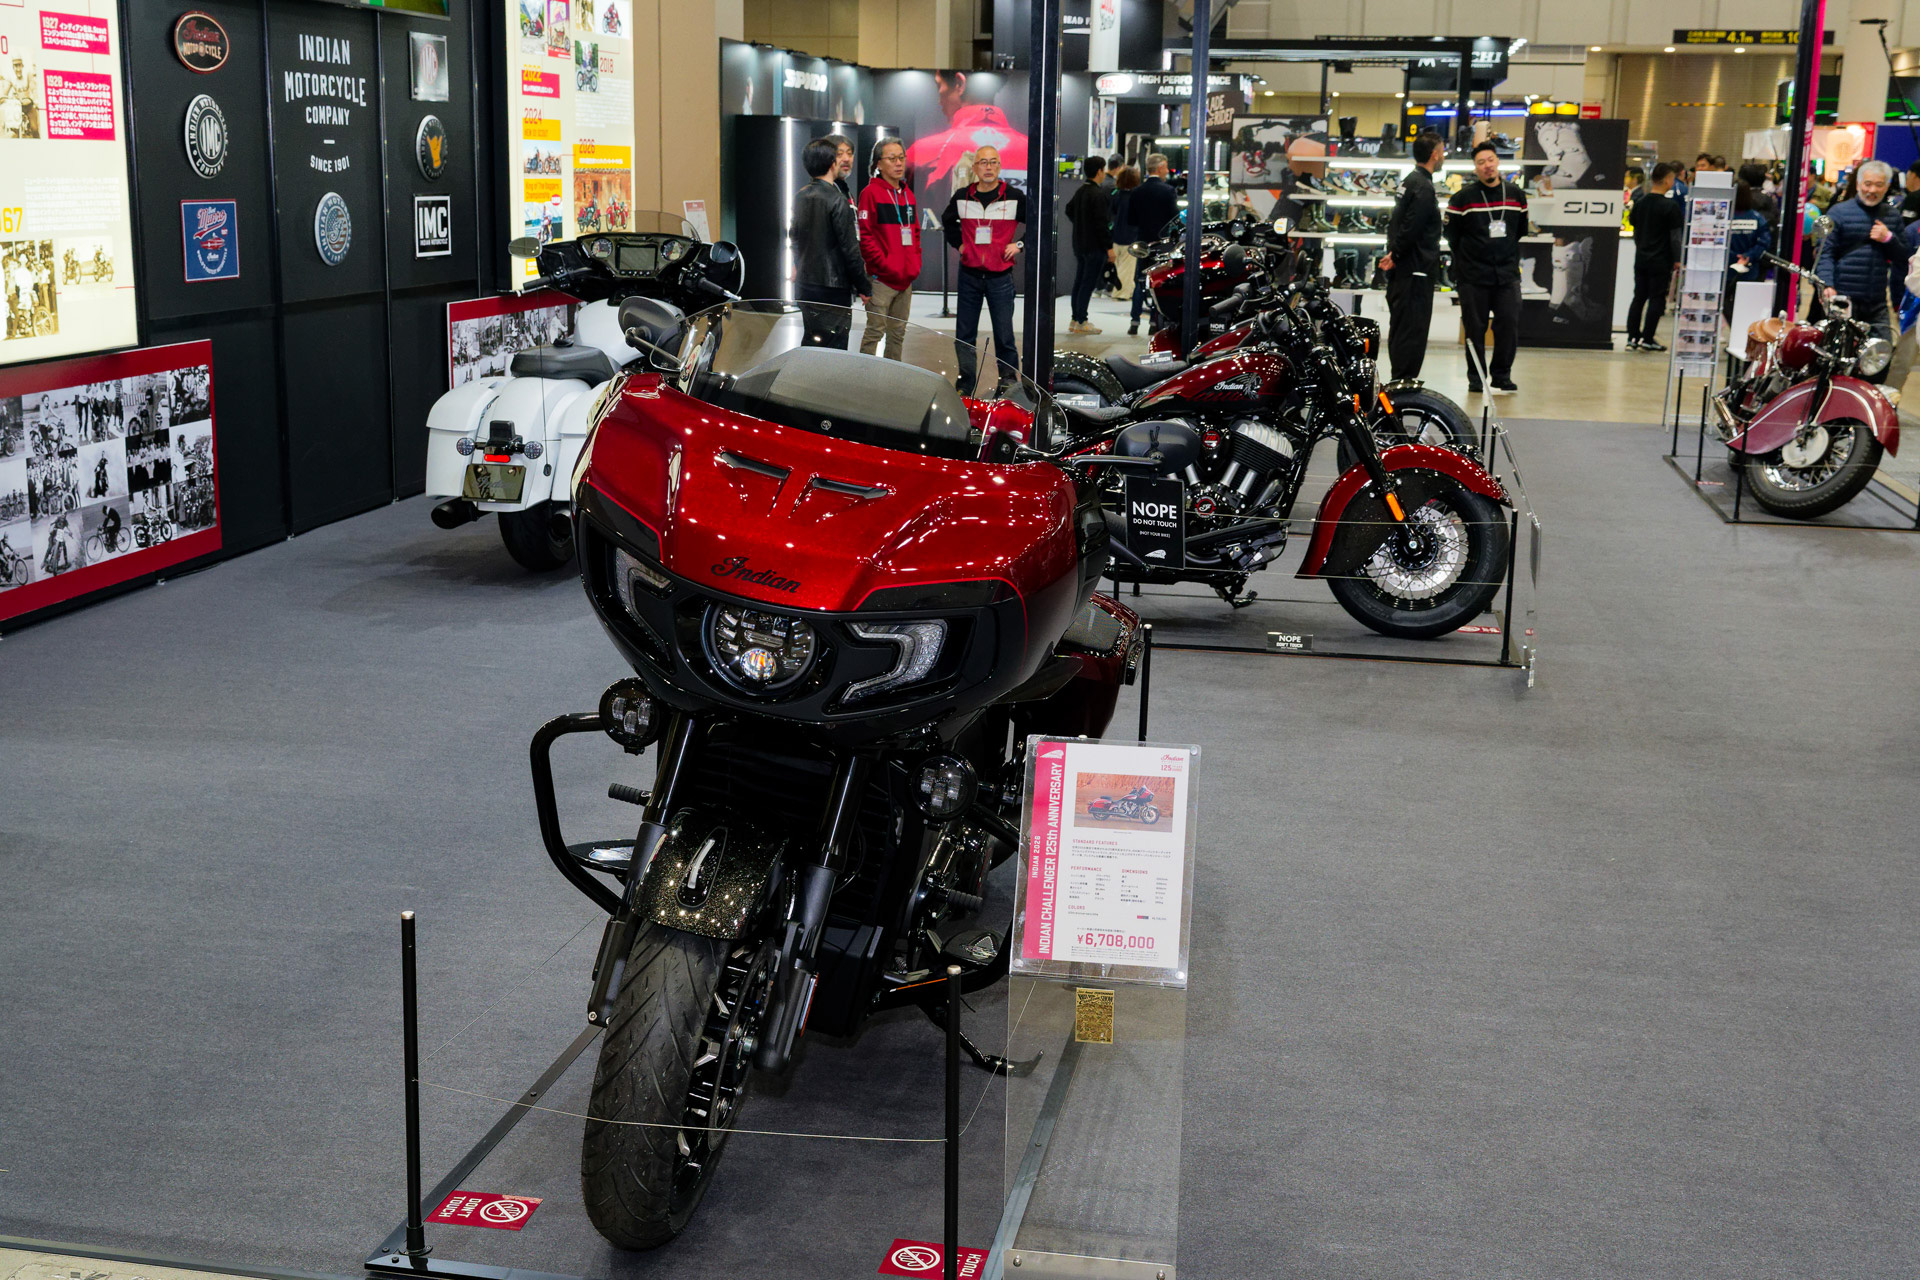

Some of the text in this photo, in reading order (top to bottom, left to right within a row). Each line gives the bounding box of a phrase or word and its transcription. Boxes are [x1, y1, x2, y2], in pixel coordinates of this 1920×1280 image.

[299, 34, 351, 65] INDIAN
[523, 64, 542, 82] 2022
[599, 57, 614, 73] 2018
[284, 71, 367, 107] MOTORCYCLE
[783, 68, 828, 93] SPIDI
[1138, 74, 1231, 86] HIGH PERFOANCE
[1157, 86, 1174, 96] AIR
[189, 105, 201, 145] INDIAN
[305, 106, 350, 126] COMPANY
[524, 107, 543, 125] 2024
[201, 118, 222, 157] IMC
[310, 154, 350, 173] SINCE 1901
[1563, 201, 1614, 215] SIDI
[0, 207, 23, 233] 67
[418, 206, 448, 239] IMC
[1213, 381, 1245, 391] Indian
[1132, 501, 1177, 519] NOPE
[1157, 520, 1177, 528] TOUCH
[710, 556, 802, 593] Indian
[1278, 635, 1302, 643] NOPE
[1039, 762, 1062, 954] INDIAN CHALLENGER 125th ANNIVERSARY
[1077, 932, 1155, 950] ¥6,708,000
[438, 1195, 467, 1218] TOUCH
[457, 1197, 482, 1218] DON'T
[959, 1253, 982, 1278] TOUCH
